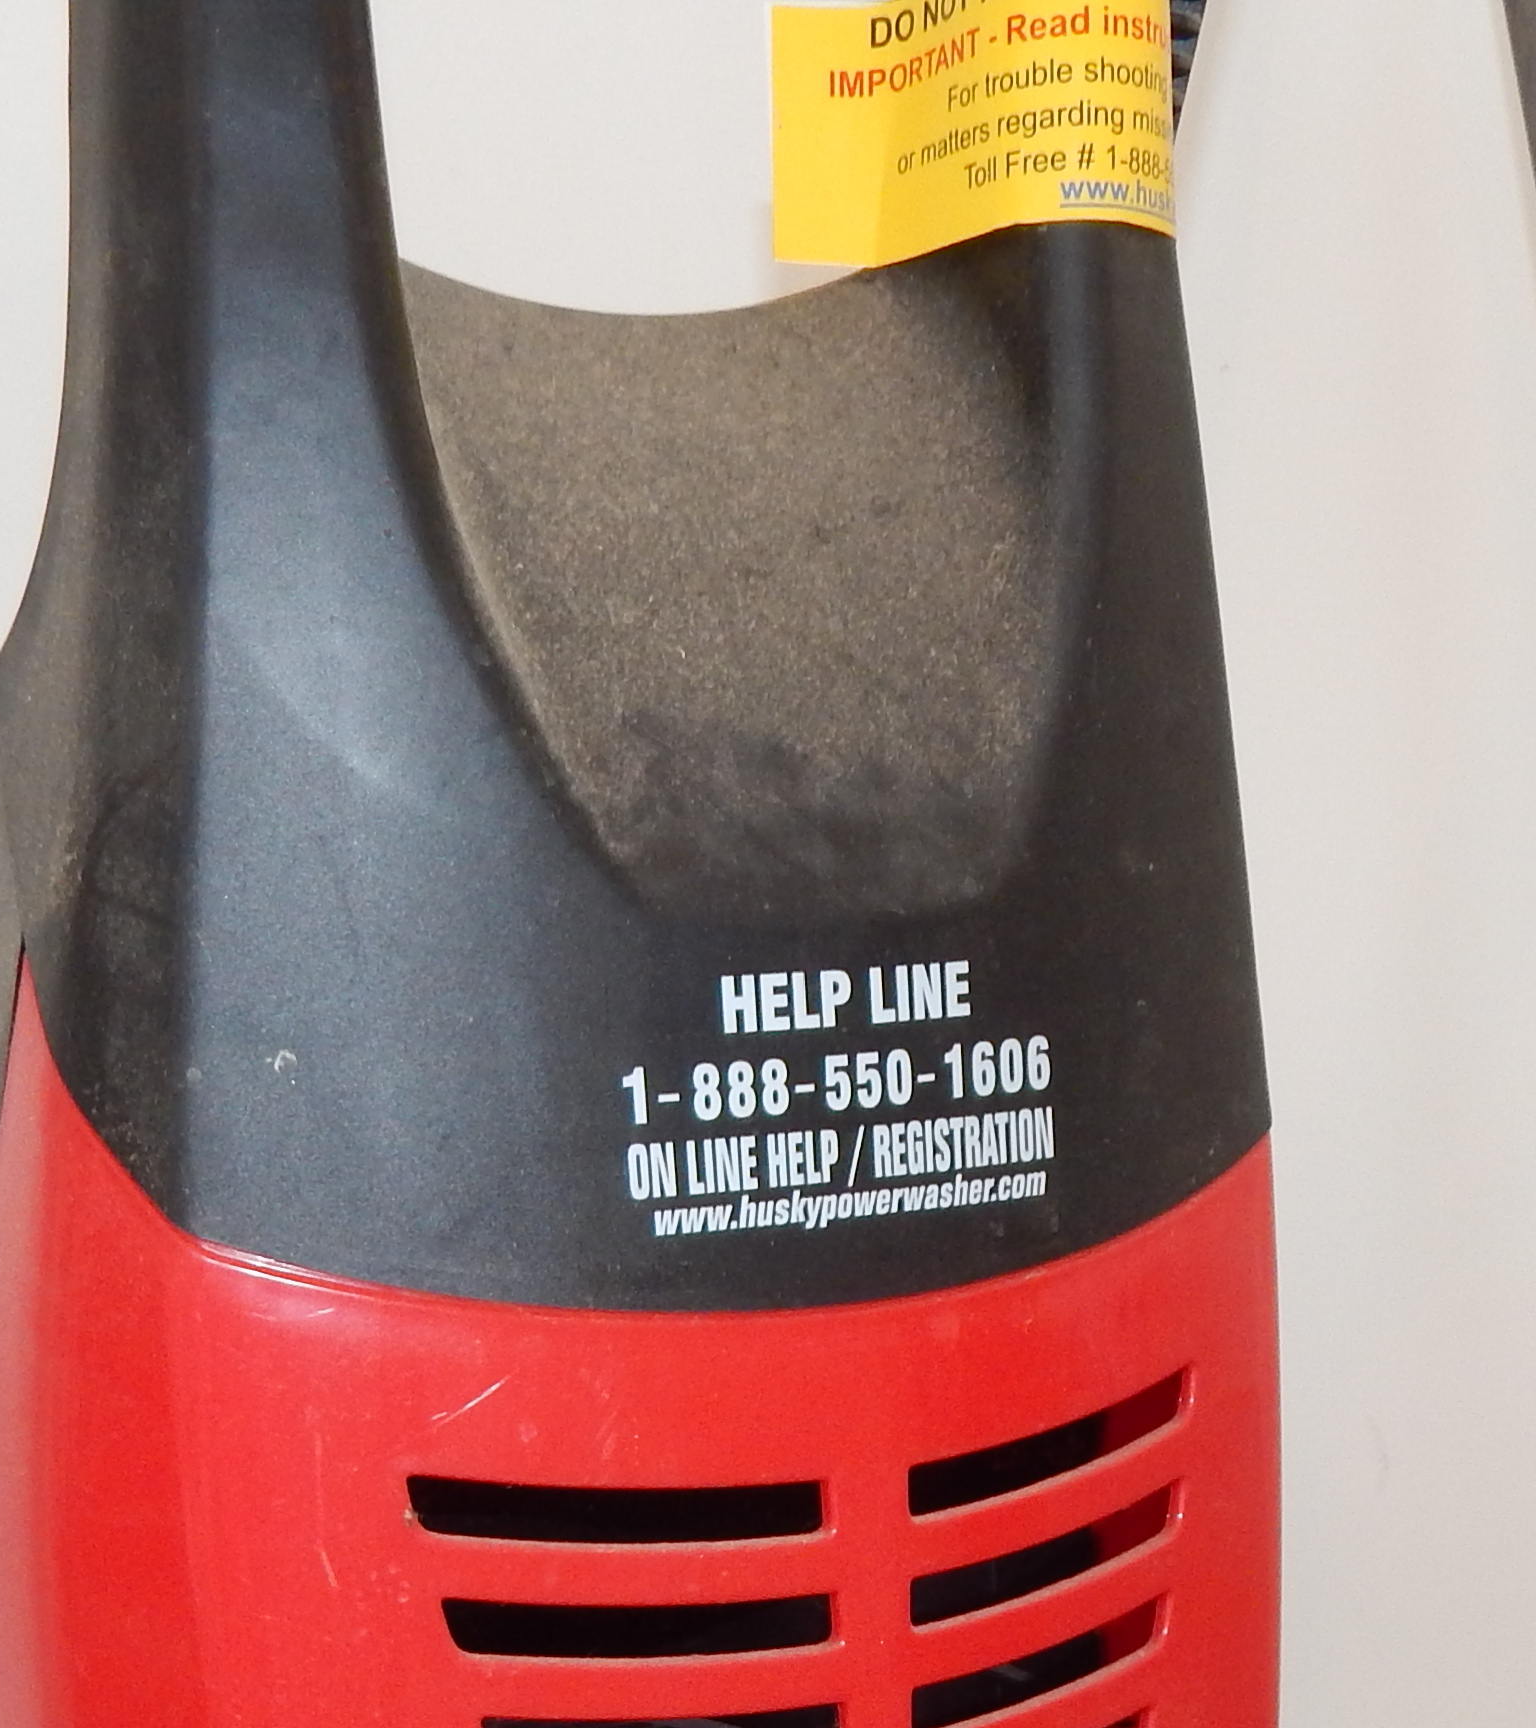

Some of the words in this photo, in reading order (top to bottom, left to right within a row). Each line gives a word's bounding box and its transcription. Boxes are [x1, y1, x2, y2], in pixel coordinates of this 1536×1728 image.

[829, 27, 981, 98] IMPORTANT
[1006, 5, 1090, 46] Read
[870, 9, 915, 48] DO
[948, 83, 979, 113] For
[985, 59, 1073, 99] trouble
[897, 151, 916, 175] or
[920, 121, 991, 167] matters
[997, 98, 1125, 139] regarding
[964, 155, 997, 190] Toll
[1005, 149, 1067, 179] Free
[1077, 142, 1096, 171] #
[720, 969, 853, 1034] HELP
[868, 959, 972, 1026] LINE
[621, 1034, 1052, 1126] 1-888-550-1606
[626, 1141, 678, 1201] ON
[685, 1134, 759, 1197] LINE
[766, 1128, 840, 1189] HELP
[847, 1124, 866, 1188] /
[873, 1105, 1056, 1179] REGISTRATION
[653, 1168, 1048, 1237] www.huskypowerwasher.com
